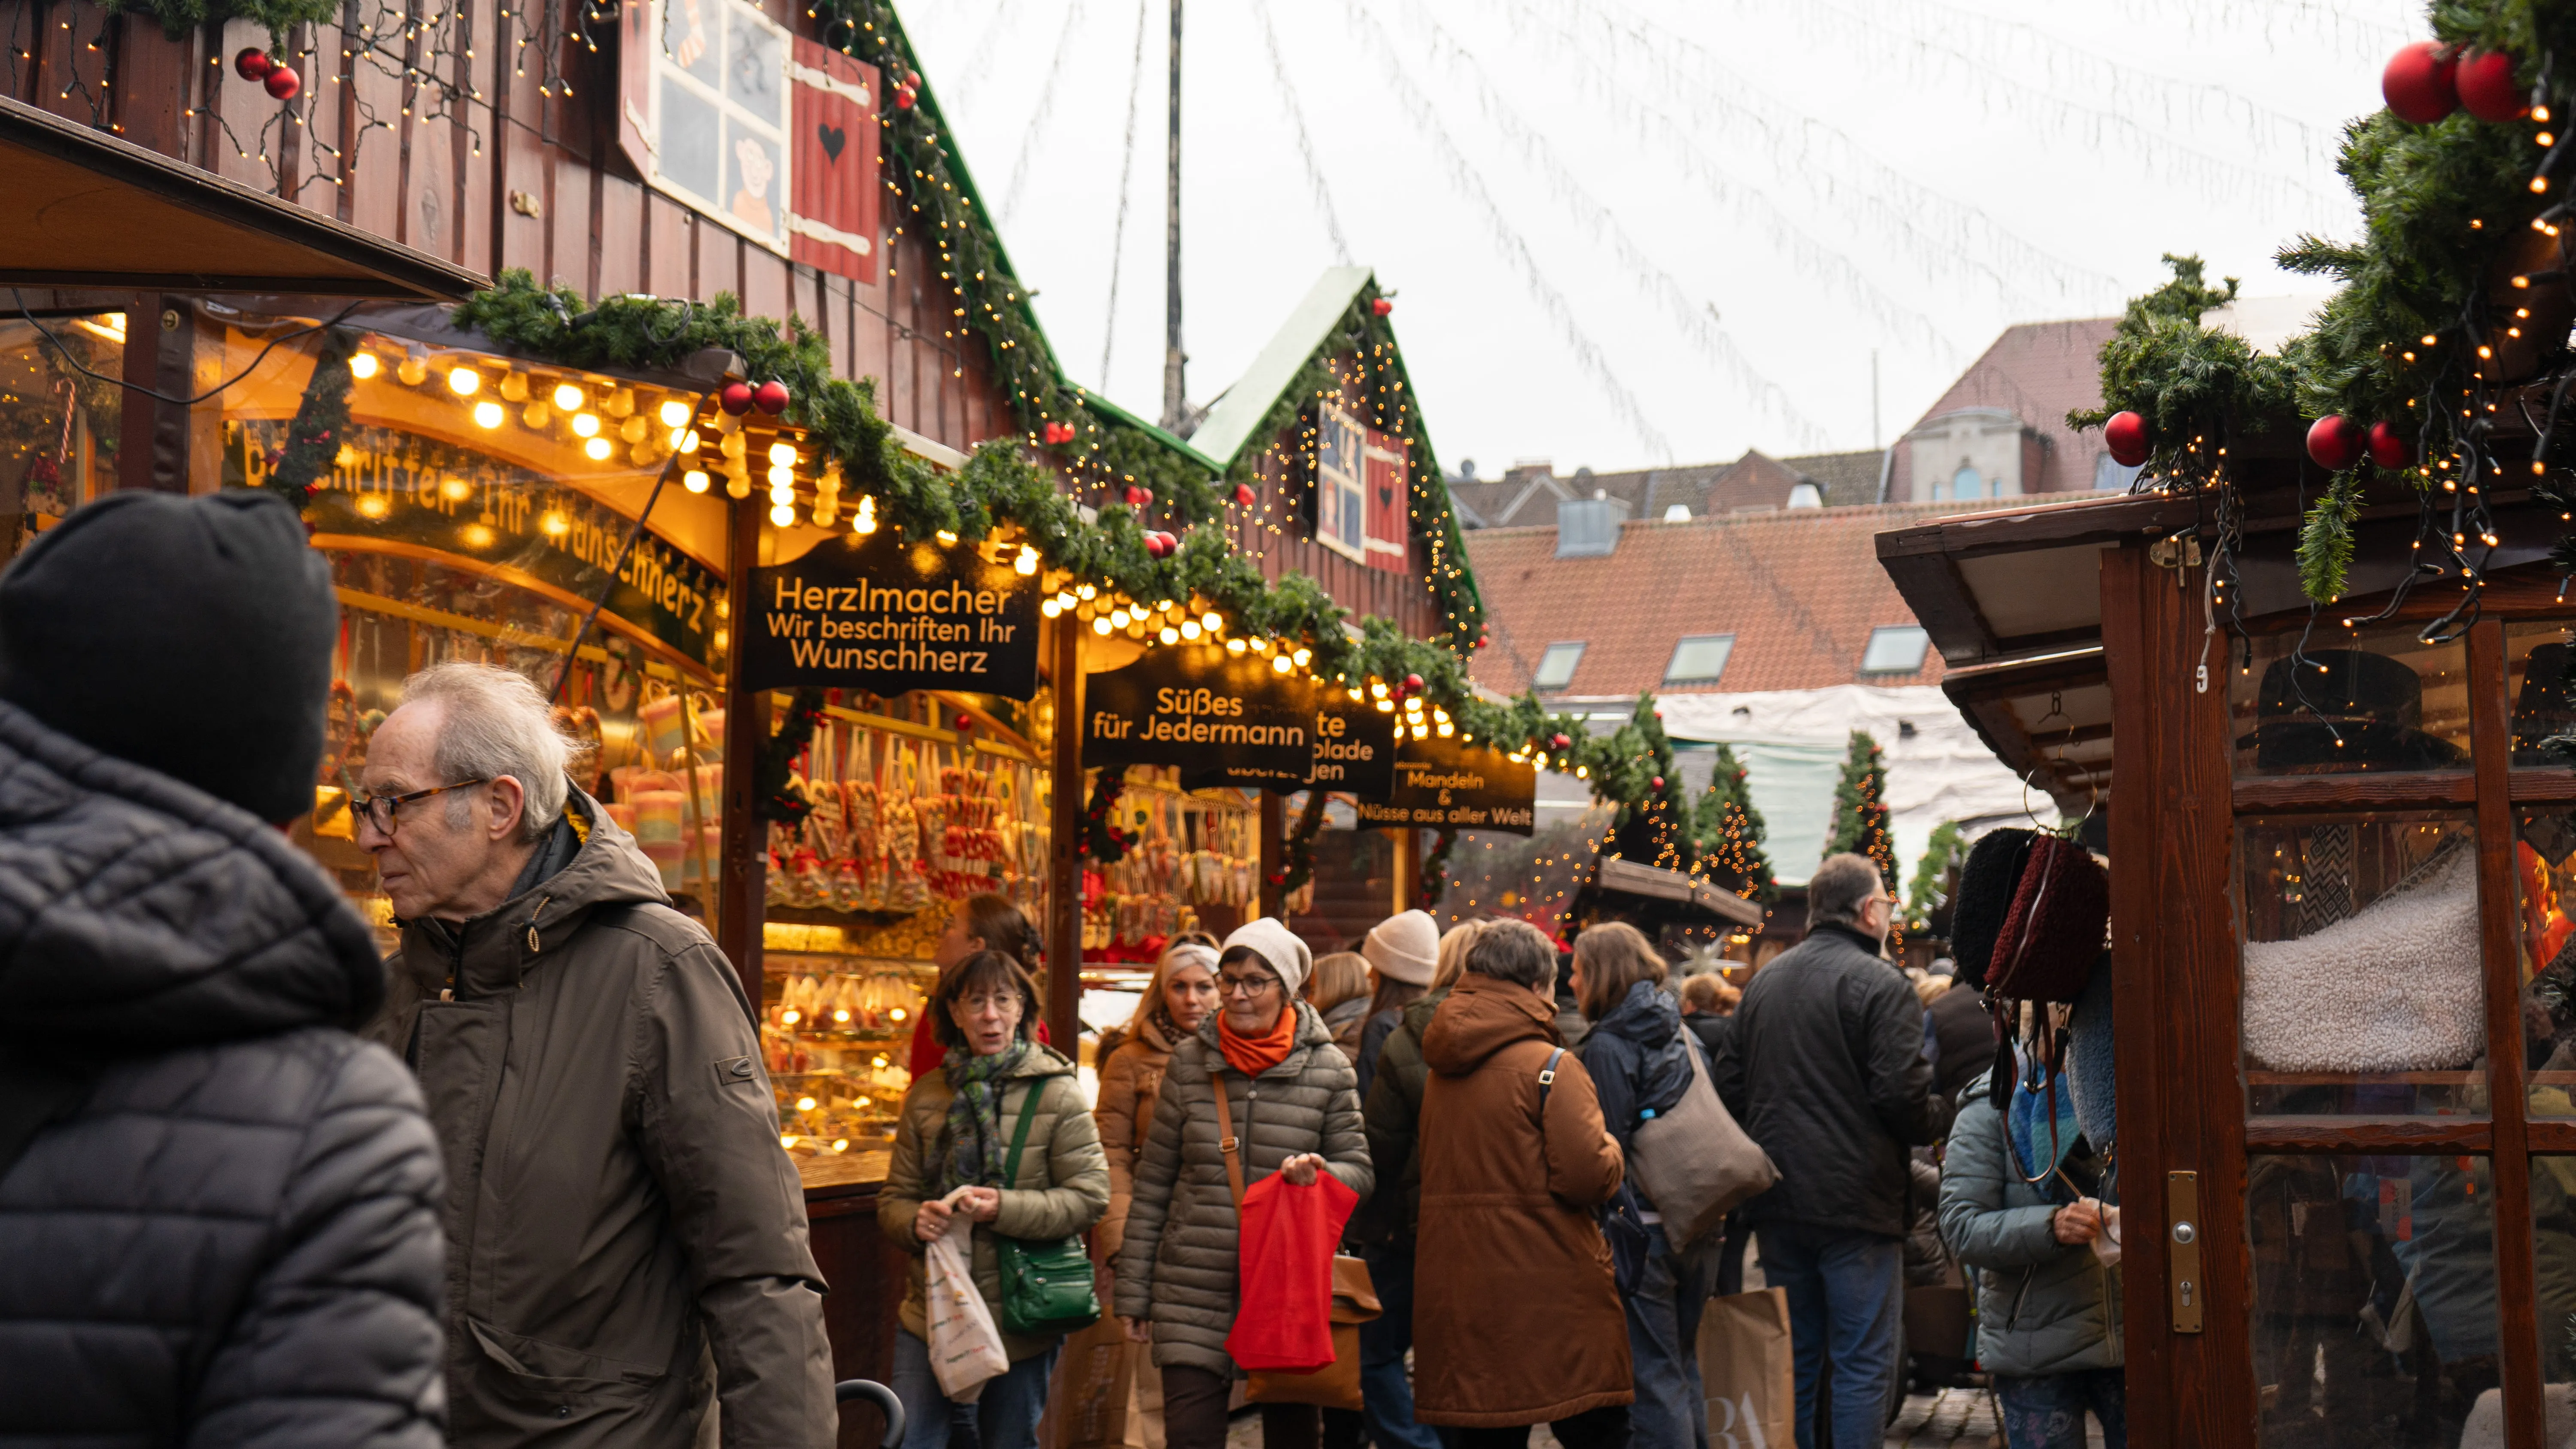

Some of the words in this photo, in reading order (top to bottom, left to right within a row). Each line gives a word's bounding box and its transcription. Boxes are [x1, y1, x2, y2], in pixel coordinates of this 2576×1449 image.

[775, 577, 1012, 614] Herzlmacher
[766, 613, 814, 638] Wir
[820, 614, 970, 642] beschriften
[980, 617, 1016, 642] Ihr
[790, 638, 988, 673] Wunschherz
[1157, 687, 1243, 717] Süßes
[1093, 711, 1133, 739] für
[1140, 714, 1304, 746] Jedermann
[1407, 770, 1484, 789] Mandeln
[1438, 788, 1452, 805] &
[1358, 802, 1409, 821] Nüsse
[1413, 808, 1444, 823] aus
[1448, 806, 1488, 824] aller
[1491, 807, 1532, 826] Welt
